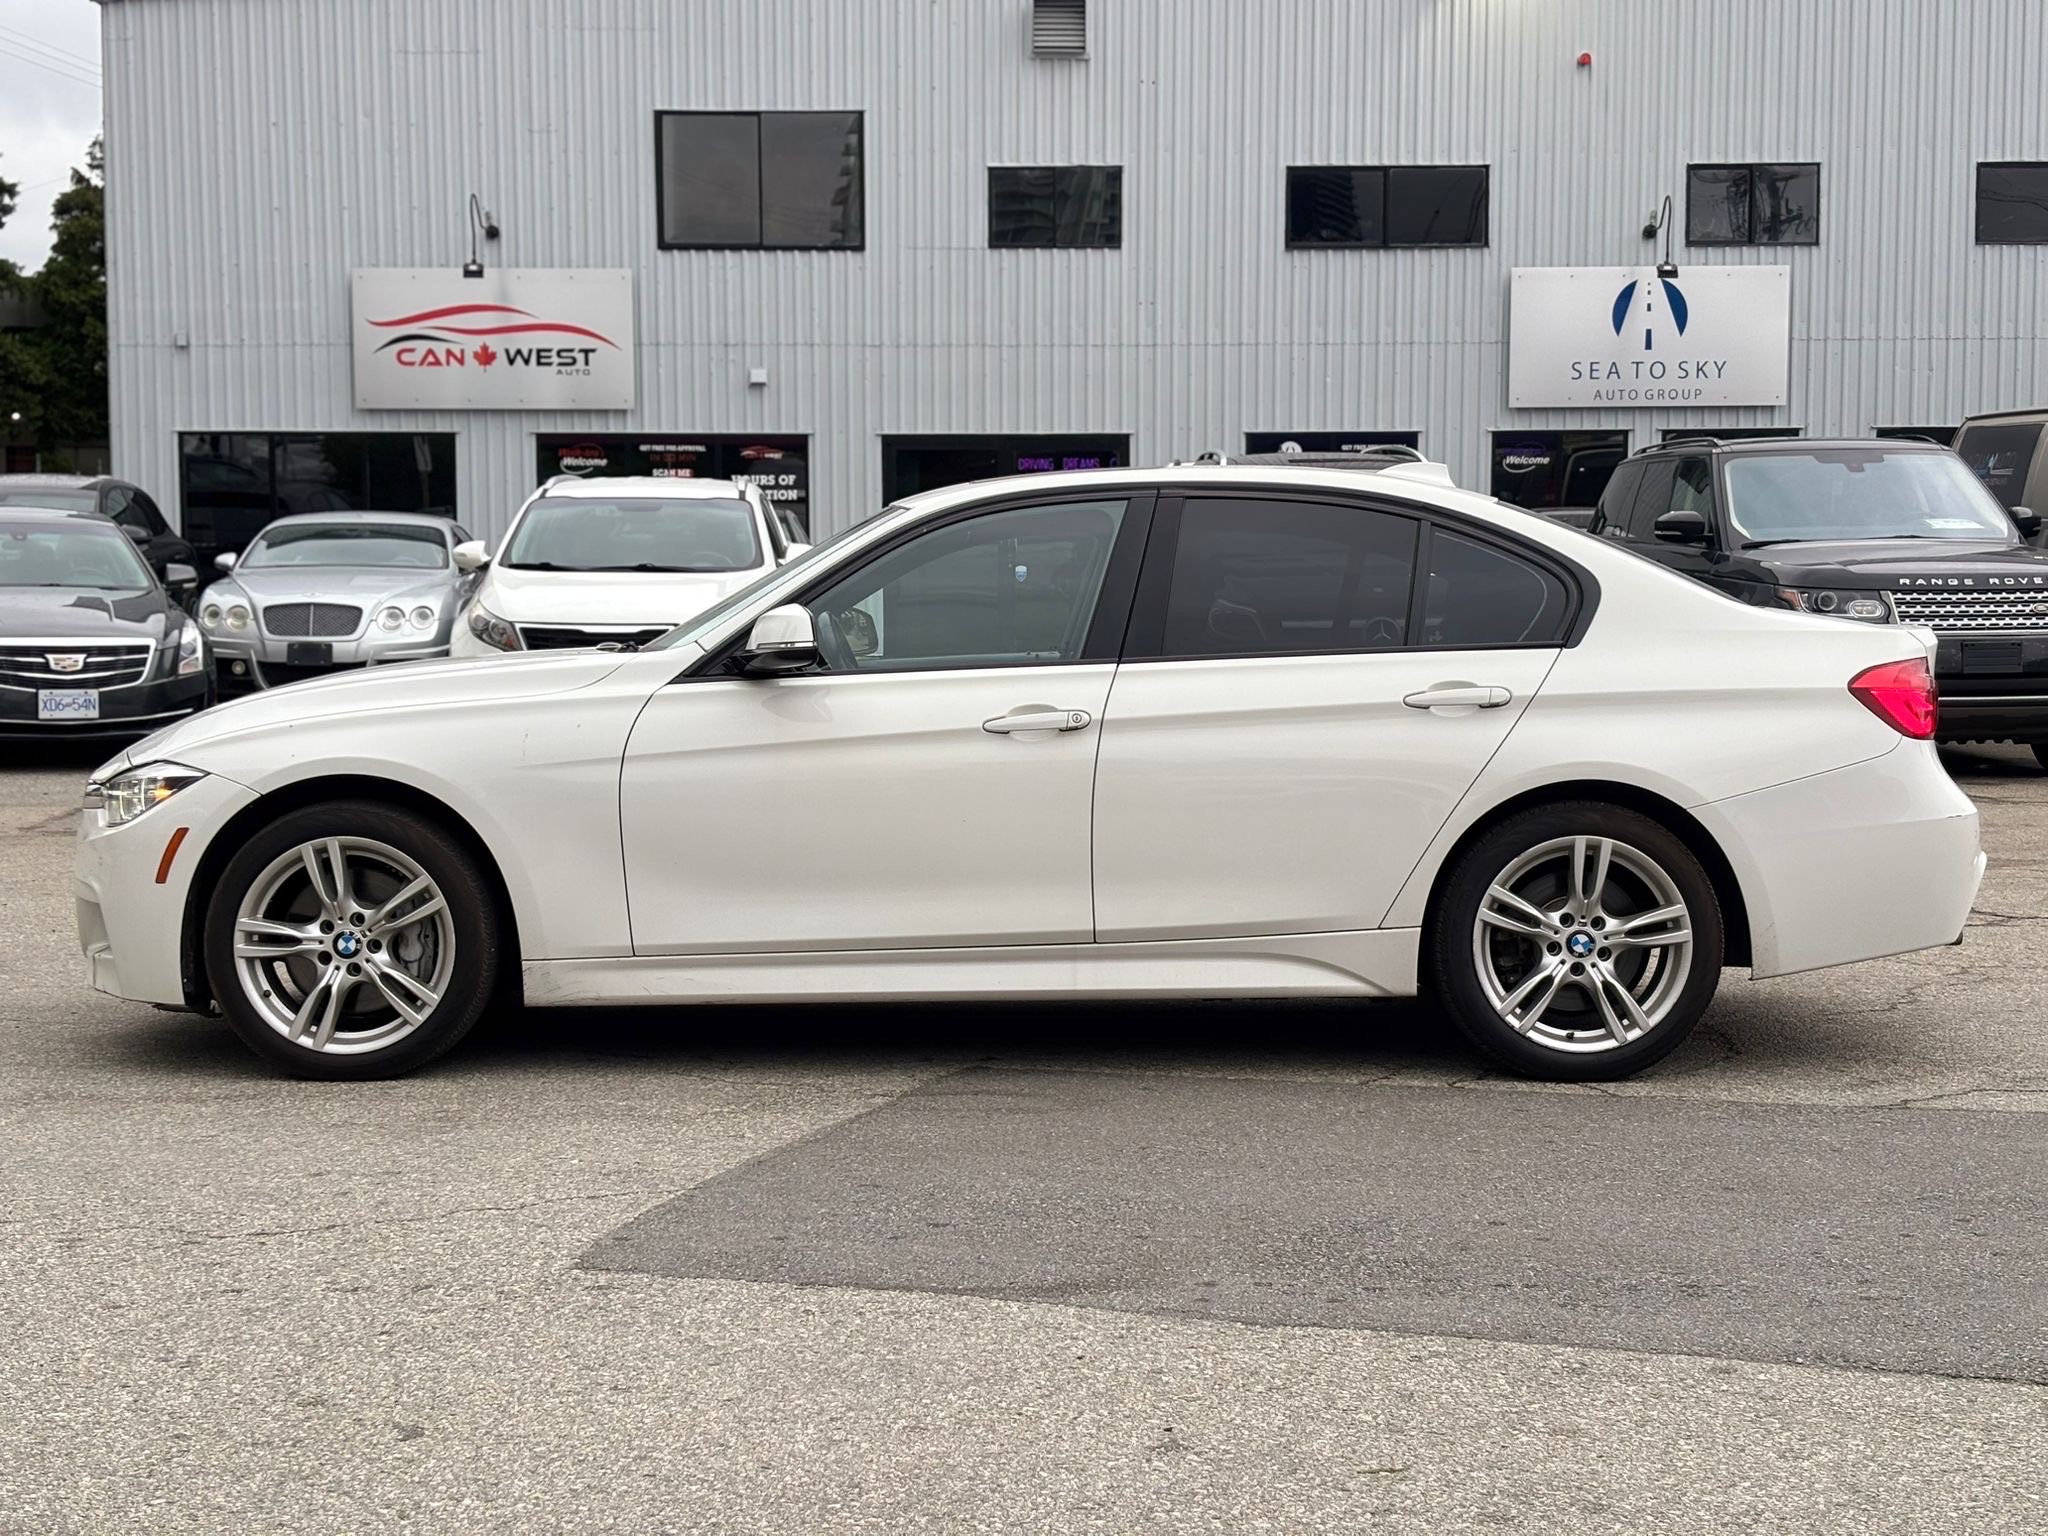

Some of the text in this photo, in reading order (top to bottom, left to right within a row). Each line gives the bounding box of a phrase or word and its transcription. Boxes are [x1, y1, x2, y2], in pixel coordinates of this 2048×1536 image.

[395, 348, 597, 367] CAN WEST
[1570, 361, 1728, 380] SEA TO SKY
[1593, 388, 1703, 401] AUTO GROUP
[563, 456, 608, 466] Welcome
[1505, 455, 1550, 465] Welcome
[778, 475, 797, 486] OF
[1989, 577, 2044, 585] ROVE
